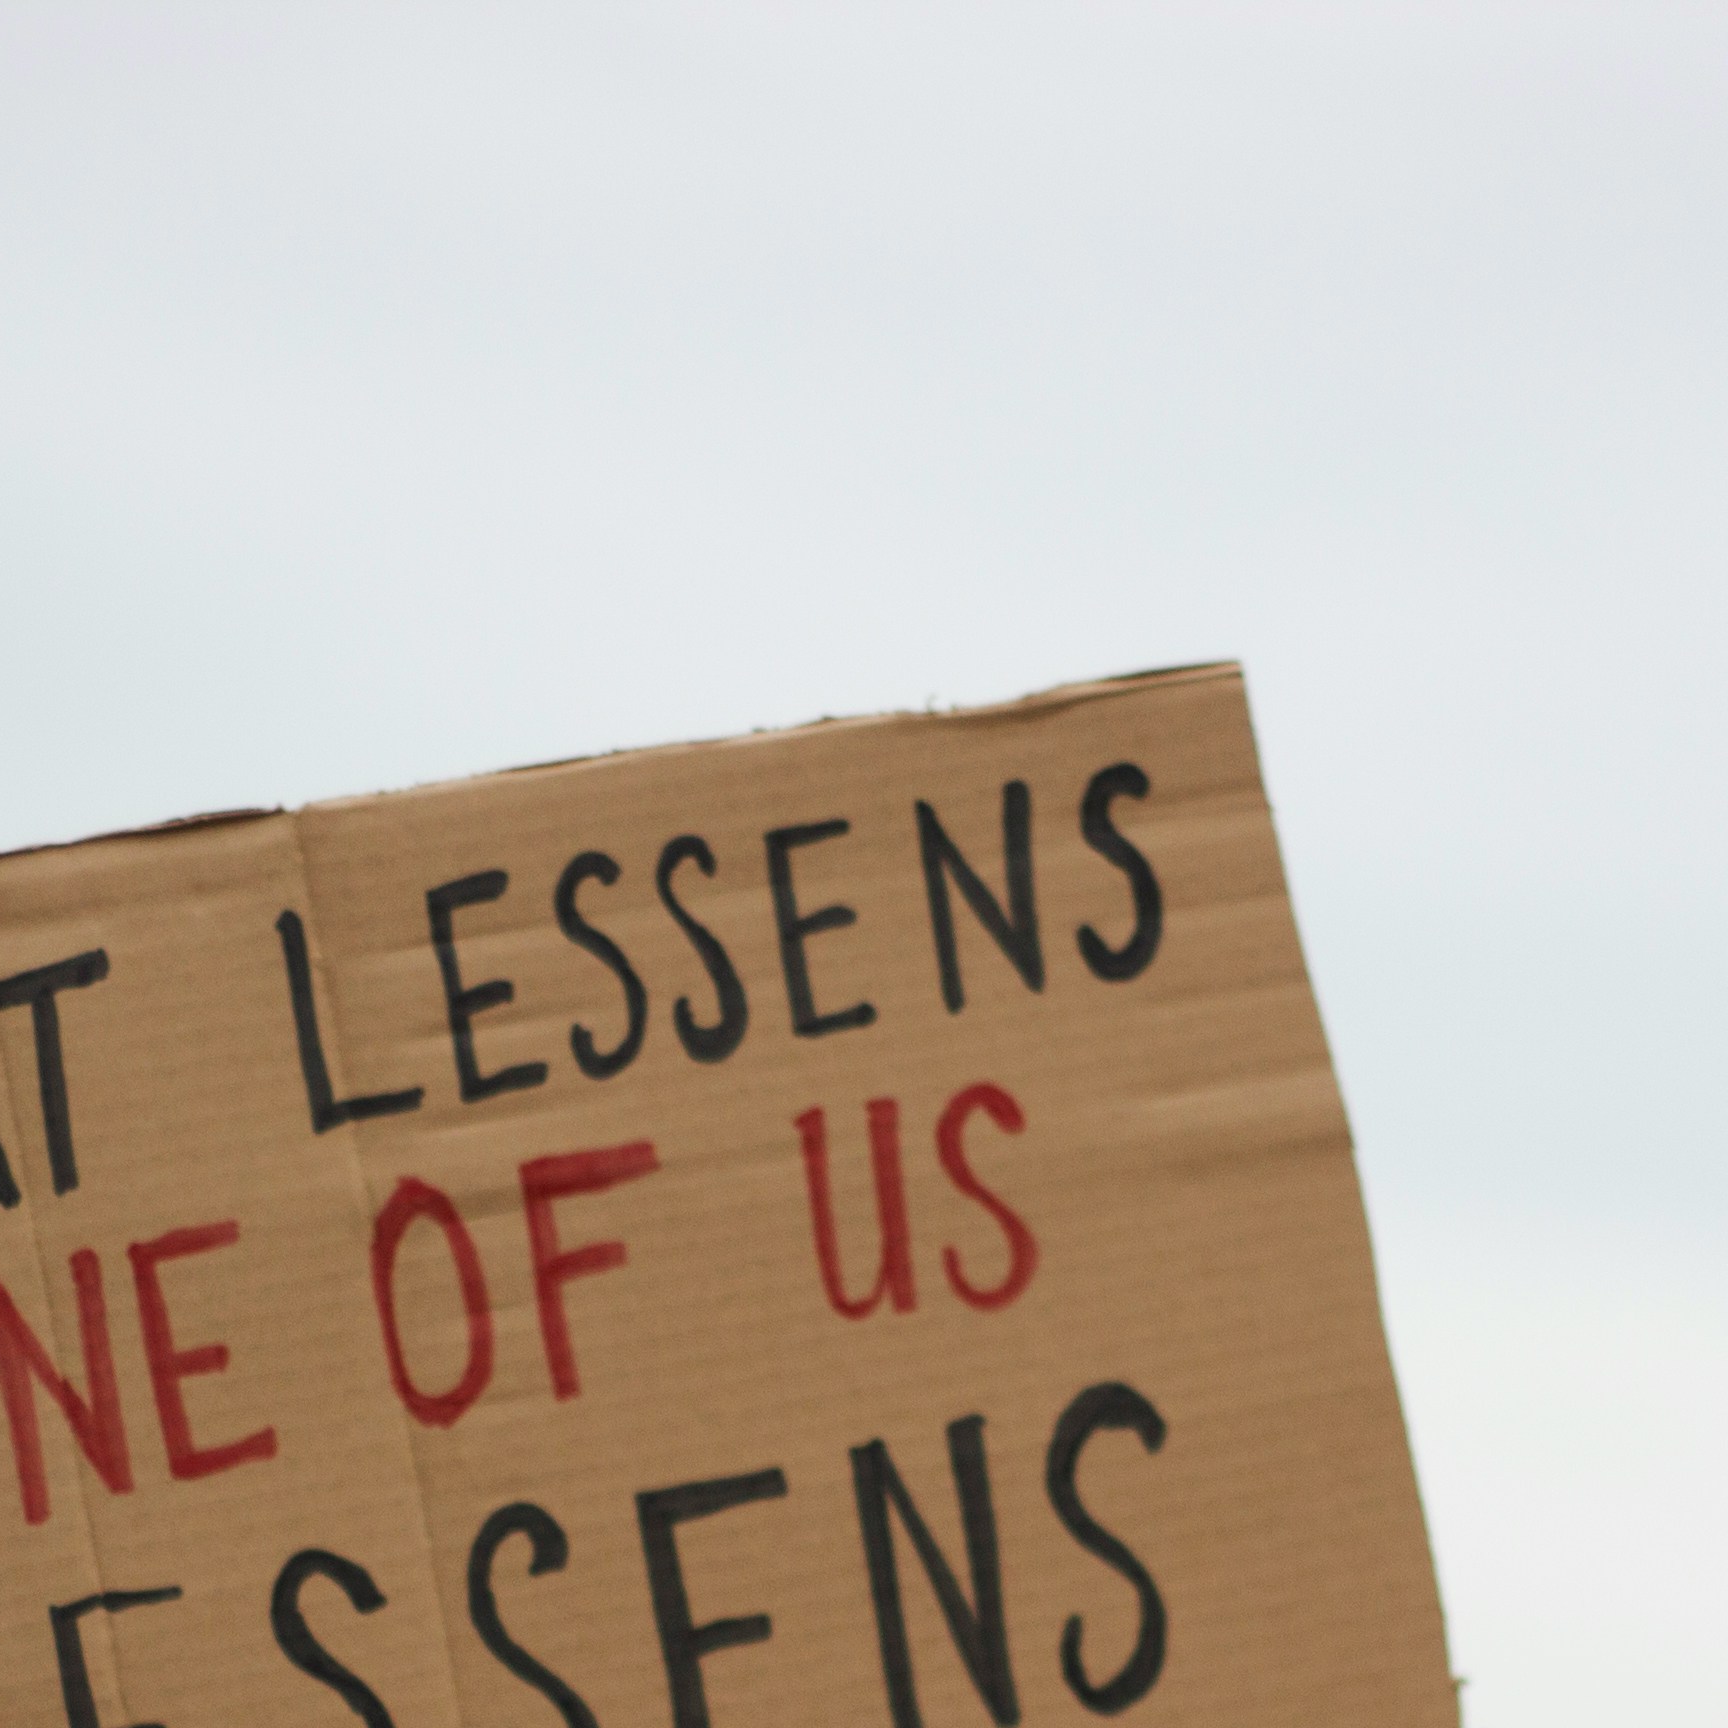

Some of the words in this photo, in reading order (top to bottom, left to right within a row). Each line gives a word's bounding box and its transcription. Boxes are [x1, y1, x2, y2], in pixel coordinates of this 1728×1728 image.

[276, 760, 1164, 1134] LESSENS
[370, 1139, 658, 1429] OF
[793, 1080, 1039, 1321] US
